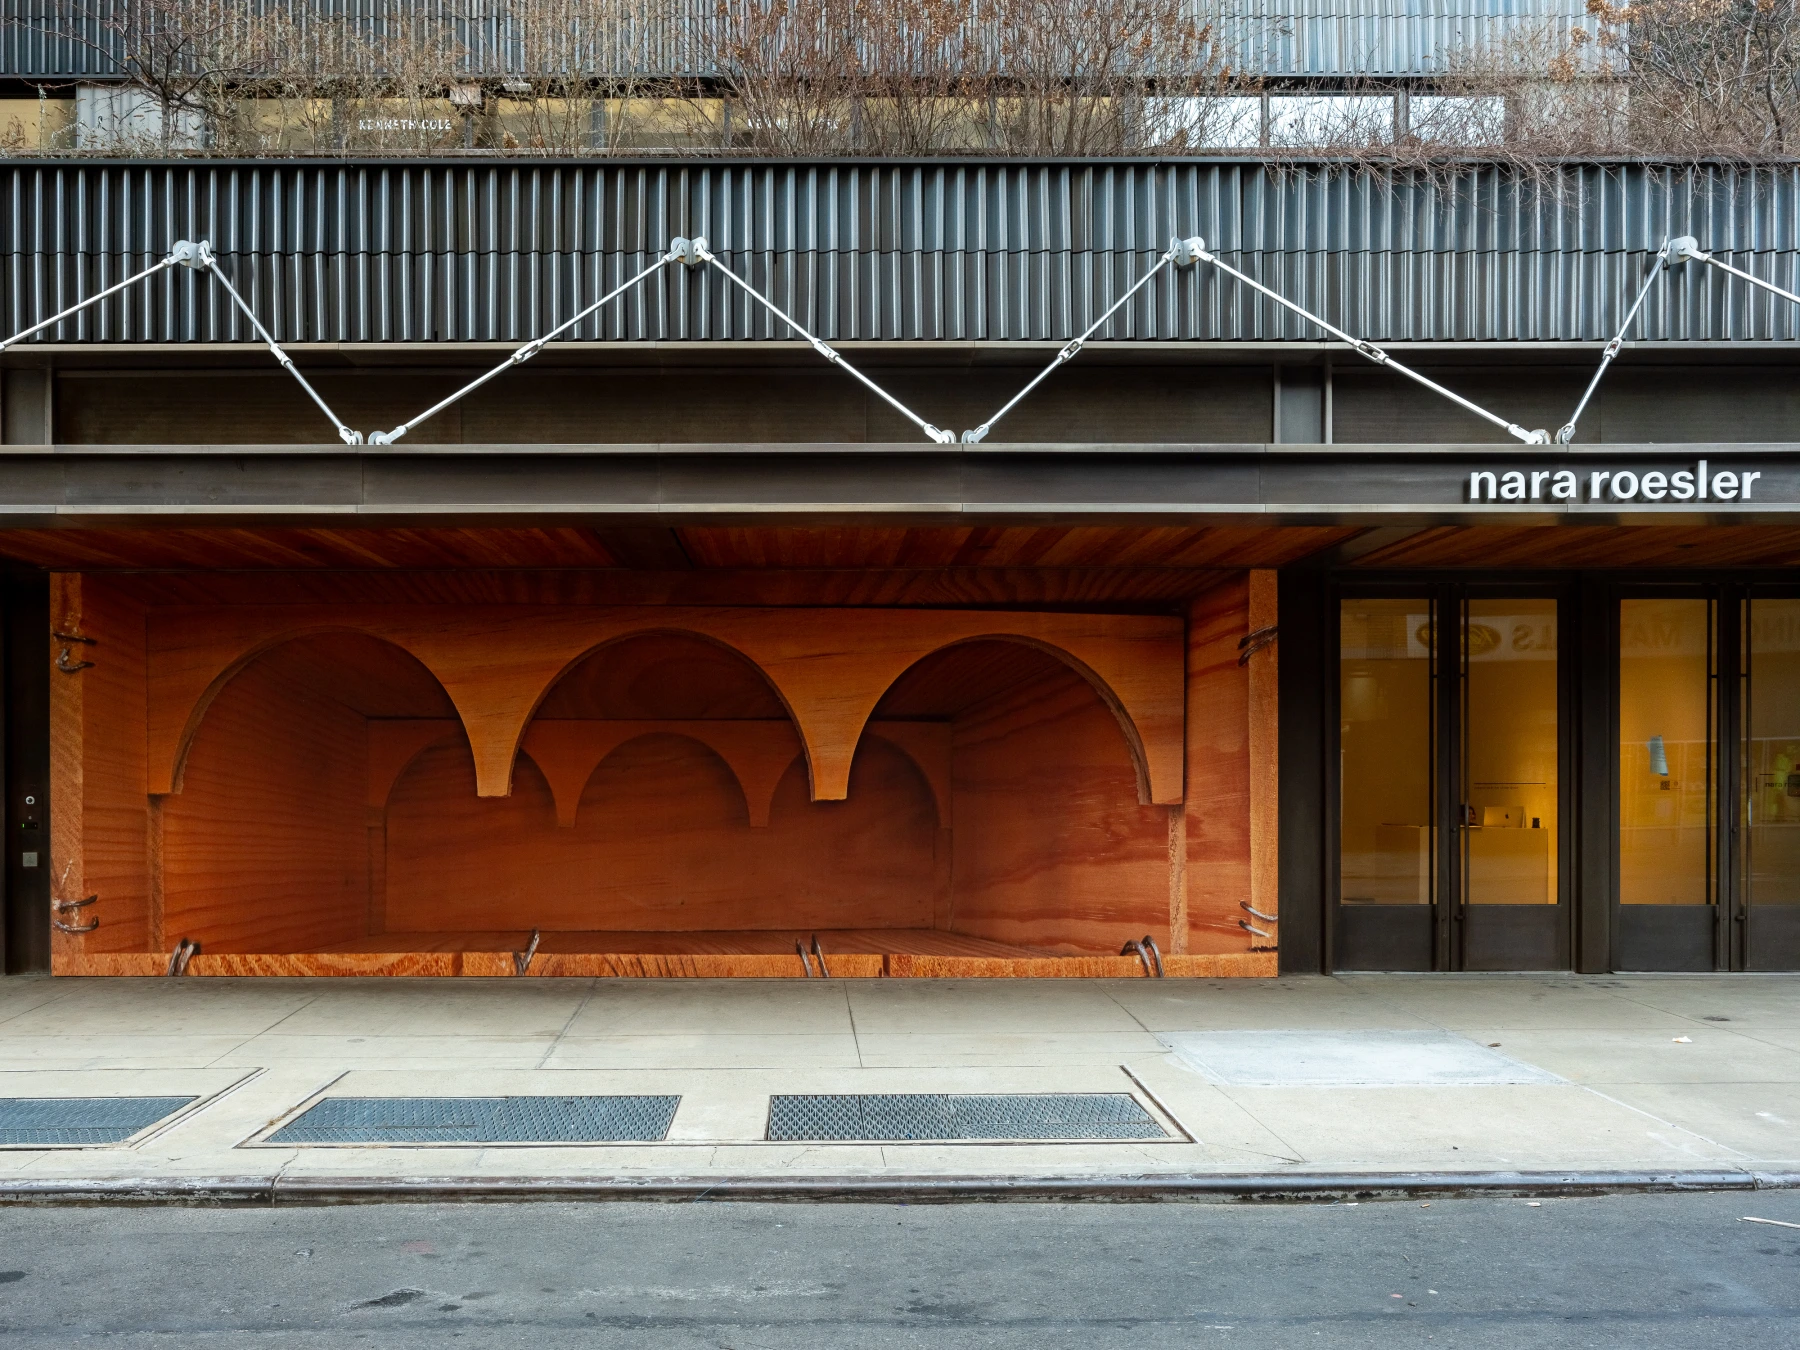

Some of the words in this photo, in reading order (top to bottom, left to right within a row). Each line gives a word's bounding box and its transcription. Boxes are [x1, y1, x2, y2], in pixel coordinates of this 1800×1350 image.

[359, 119, 416, 130] KENNETH
[421, 119, 452, 130] COLE
[1470, 470, 1577, 499] nara
[1591, 460, 1760, 499] roesler
